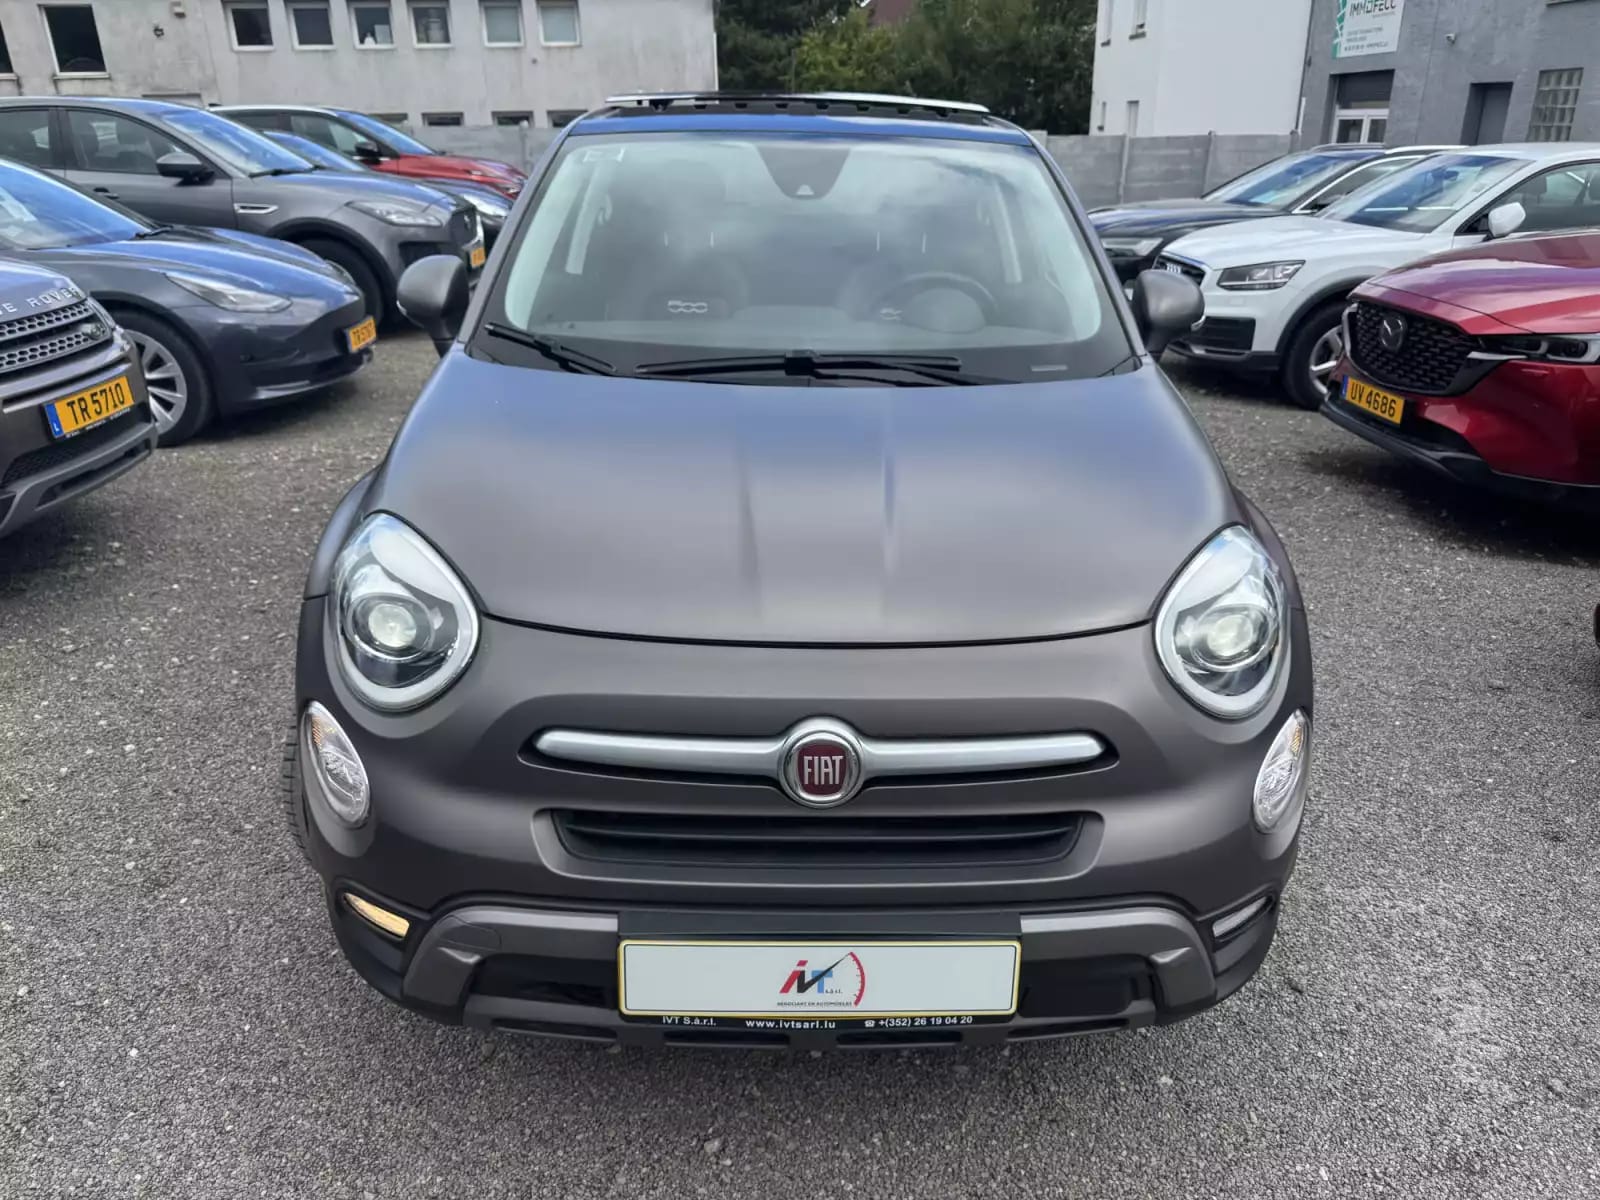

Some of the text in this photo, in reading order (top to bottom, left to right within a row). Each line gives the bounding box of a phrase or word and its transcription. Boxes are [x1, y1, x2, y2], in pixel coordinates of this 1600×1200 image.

[26, 287, 83, 308] ROVER
[66, 397, 92, 425] TR
[90, 382, 125, 416] 5710
[1351, 381, 1396, 417] UV 4686
[803, 755, 844, 785] FIAT
[662, 1015, 680, 1024] IVT
[745, 1019, 836, 1029] www.ivtsarl.lu
[878, 1015, 973, 1027] +(352) 26 19 04 20
